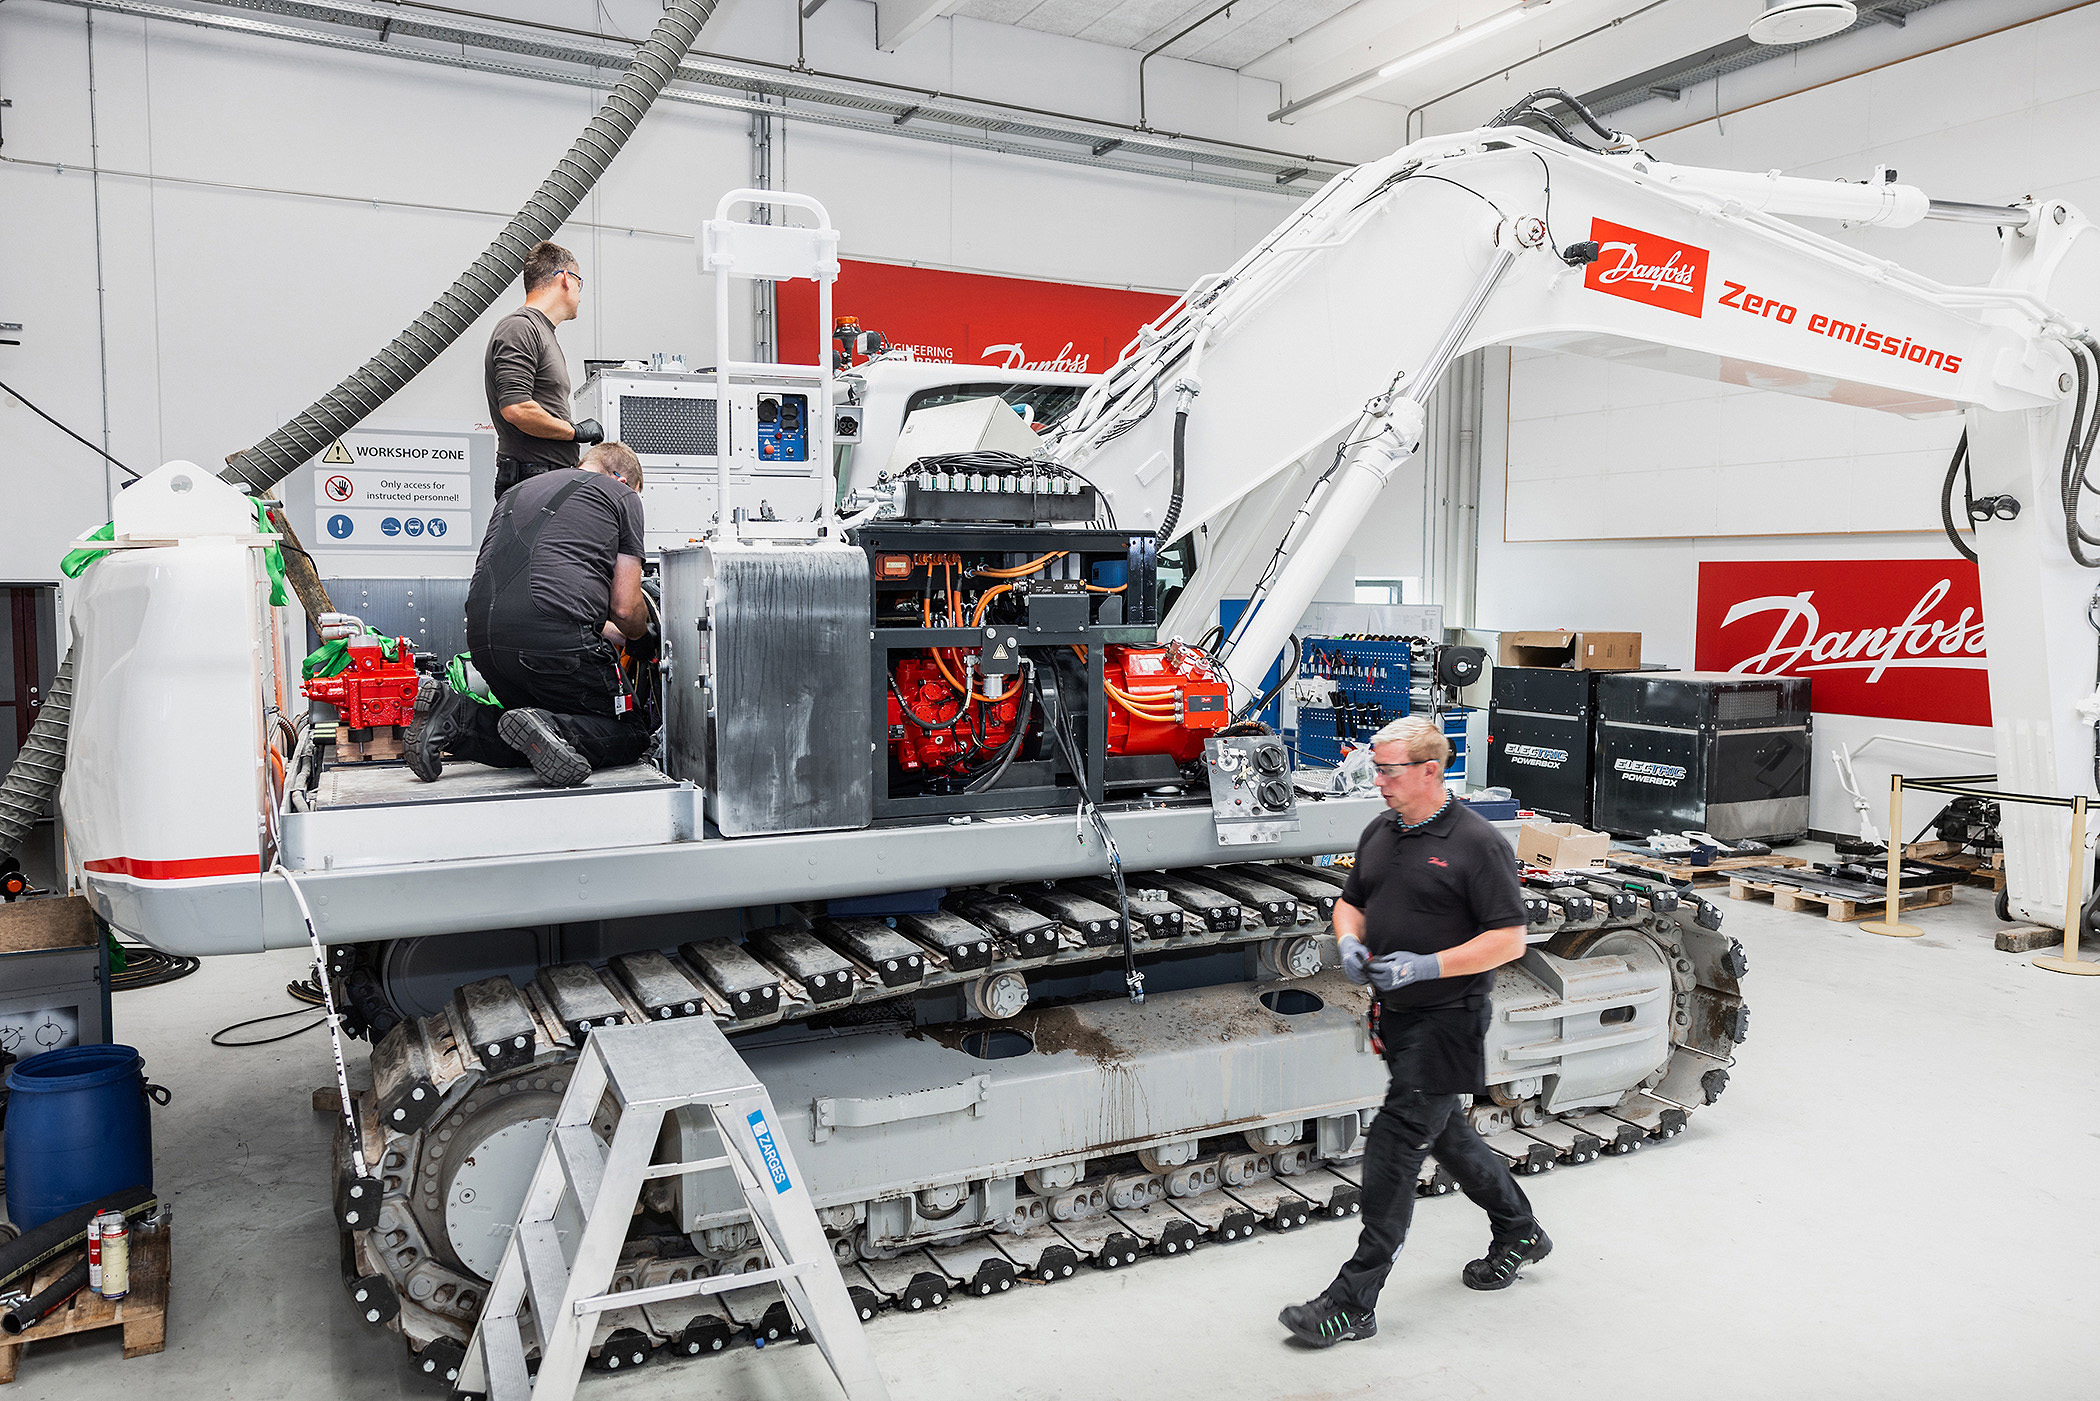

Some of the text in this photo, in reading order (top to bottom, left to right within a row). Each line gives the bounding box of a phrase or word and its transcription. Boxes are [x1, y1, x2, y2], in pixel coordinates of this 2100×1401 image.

[1598, 241, 1694, 293] Danfoss
[1718, 280, 1963, 374] Zero emissions
[356, 446, 465, 460] WORKSHOP ZONE
[380, 479, 402, 489] Only
[433, 481, 446, 489] for
[366, 491, 459, 502] instructed personnel!
[1504, 742, 1569, 763] ELECTRIC
[1511, 756, 1561, 770] POWERBOX
[1613, 757, 1687, 780] ELECTRIC
[1621, 772, 1678, 788] POWERBOX
[758, 1133, 786, 1184] ZARGES
